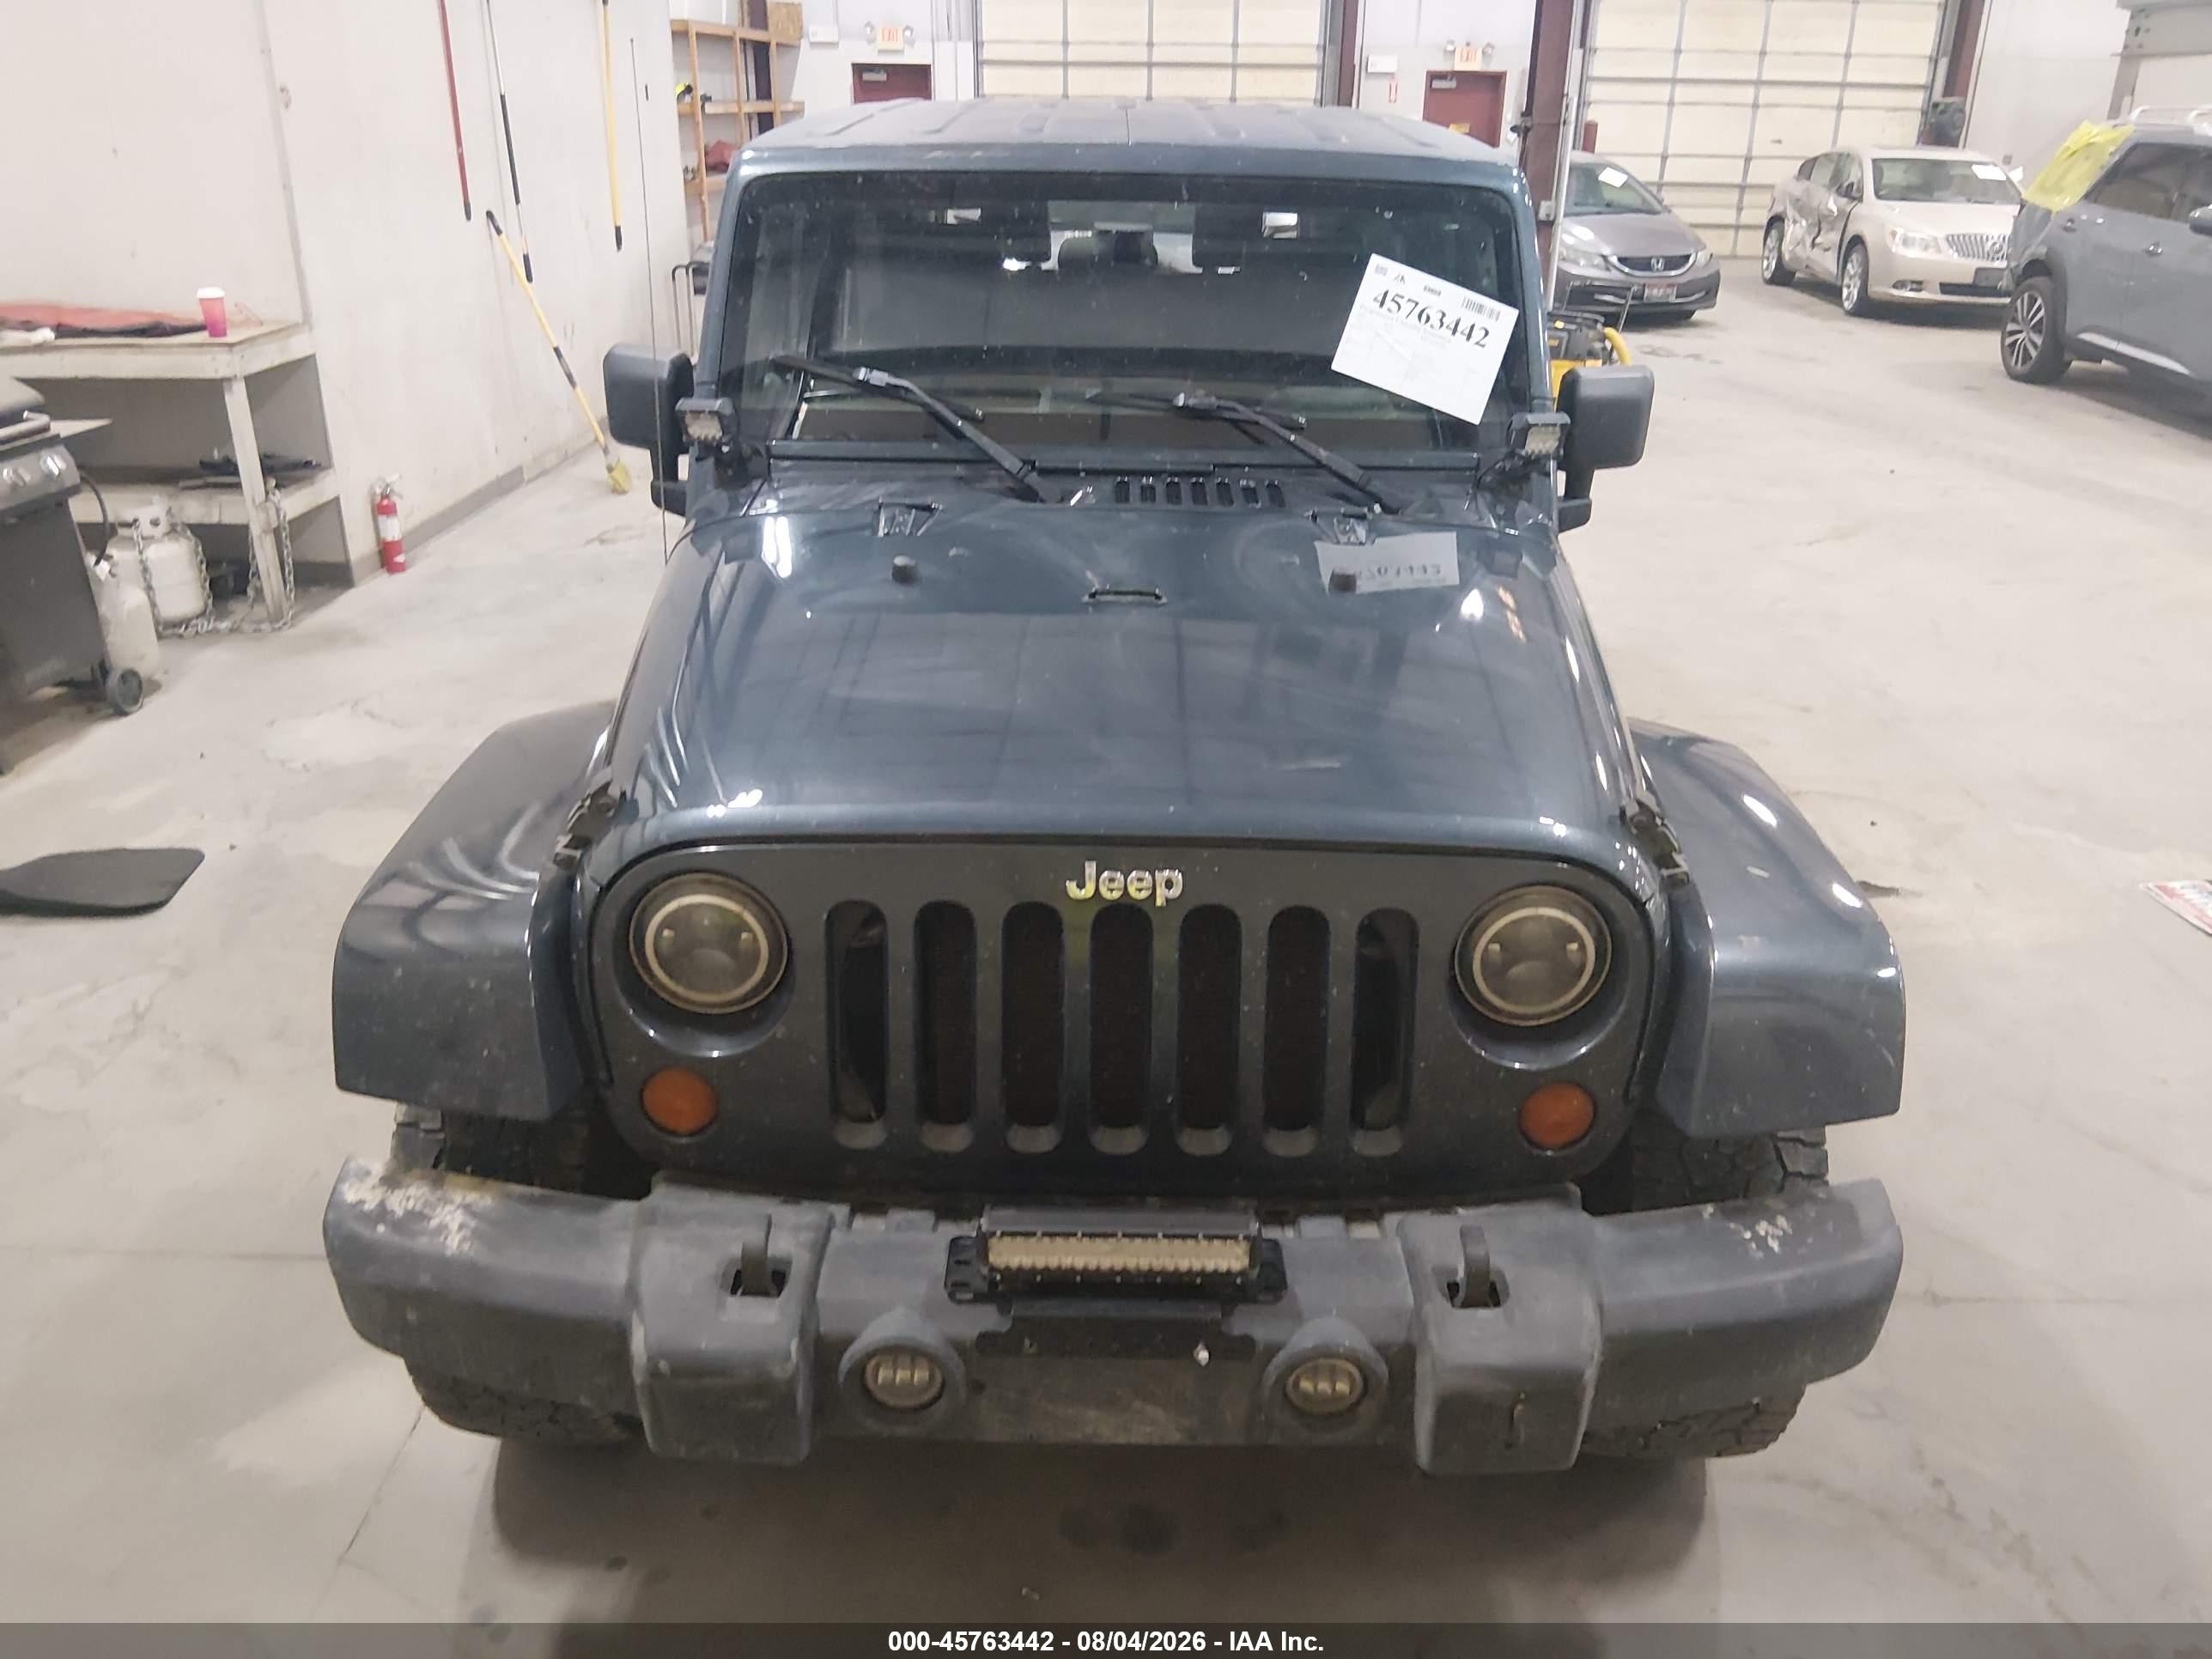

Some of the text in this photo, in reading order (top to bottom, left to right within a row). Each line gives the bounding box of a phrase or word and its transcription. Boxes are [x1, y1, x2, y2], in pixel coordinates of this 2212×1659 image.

[881, 27, 899, 41] EXIT
[1461, 48, 1477, 62] EXIT
[1373, 289, 1490, 349] 45763442
[1066, 860, 1183, 907] Jeep
